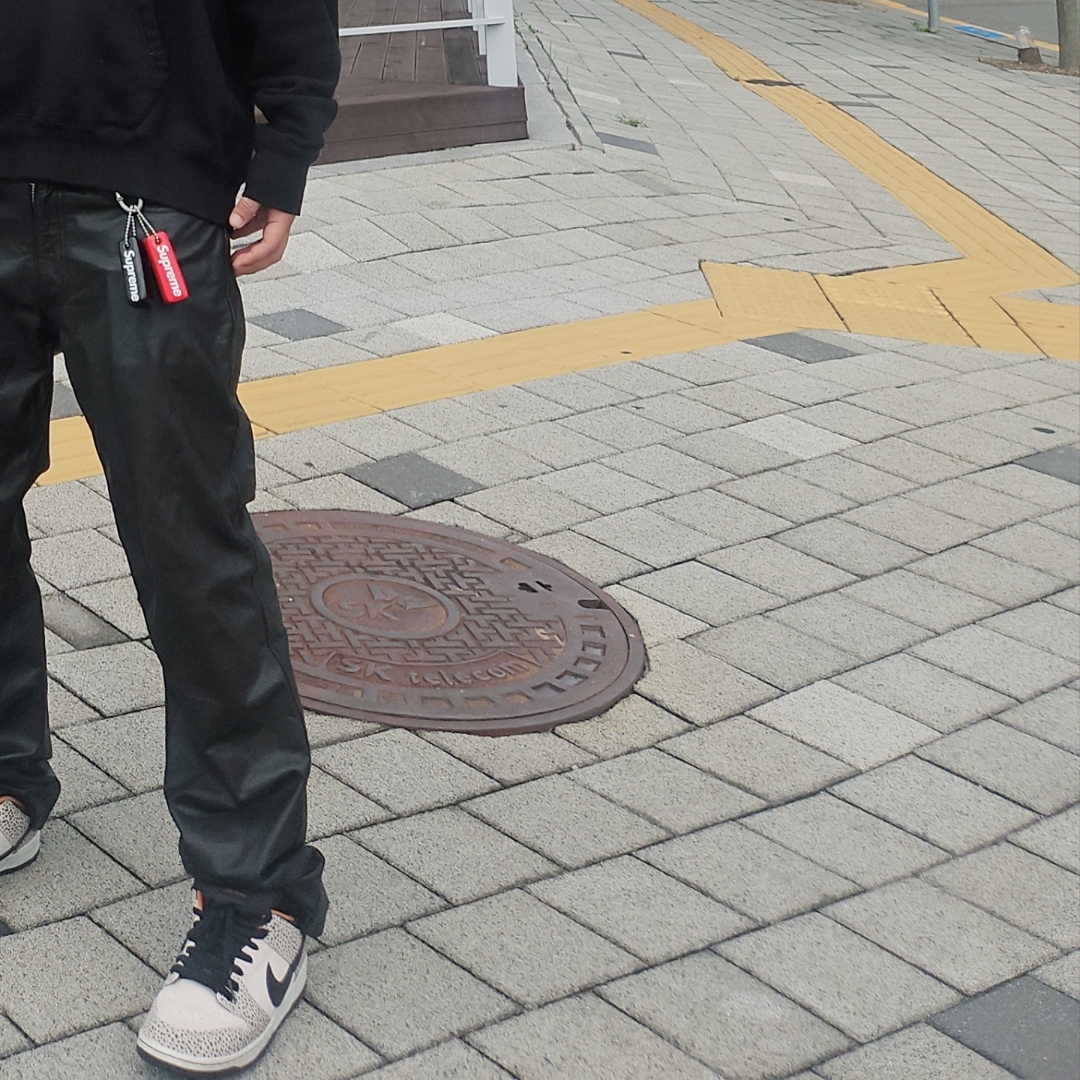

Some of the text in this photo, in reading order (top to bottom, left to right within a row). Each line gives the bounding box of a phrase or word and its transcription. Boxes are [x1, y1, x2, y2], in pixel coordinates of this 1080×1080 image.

[123, 249, 140, 302] Supreme
[156, 244, 182, 298] Supreme
[334, 653, 531, 688] SK telecom
